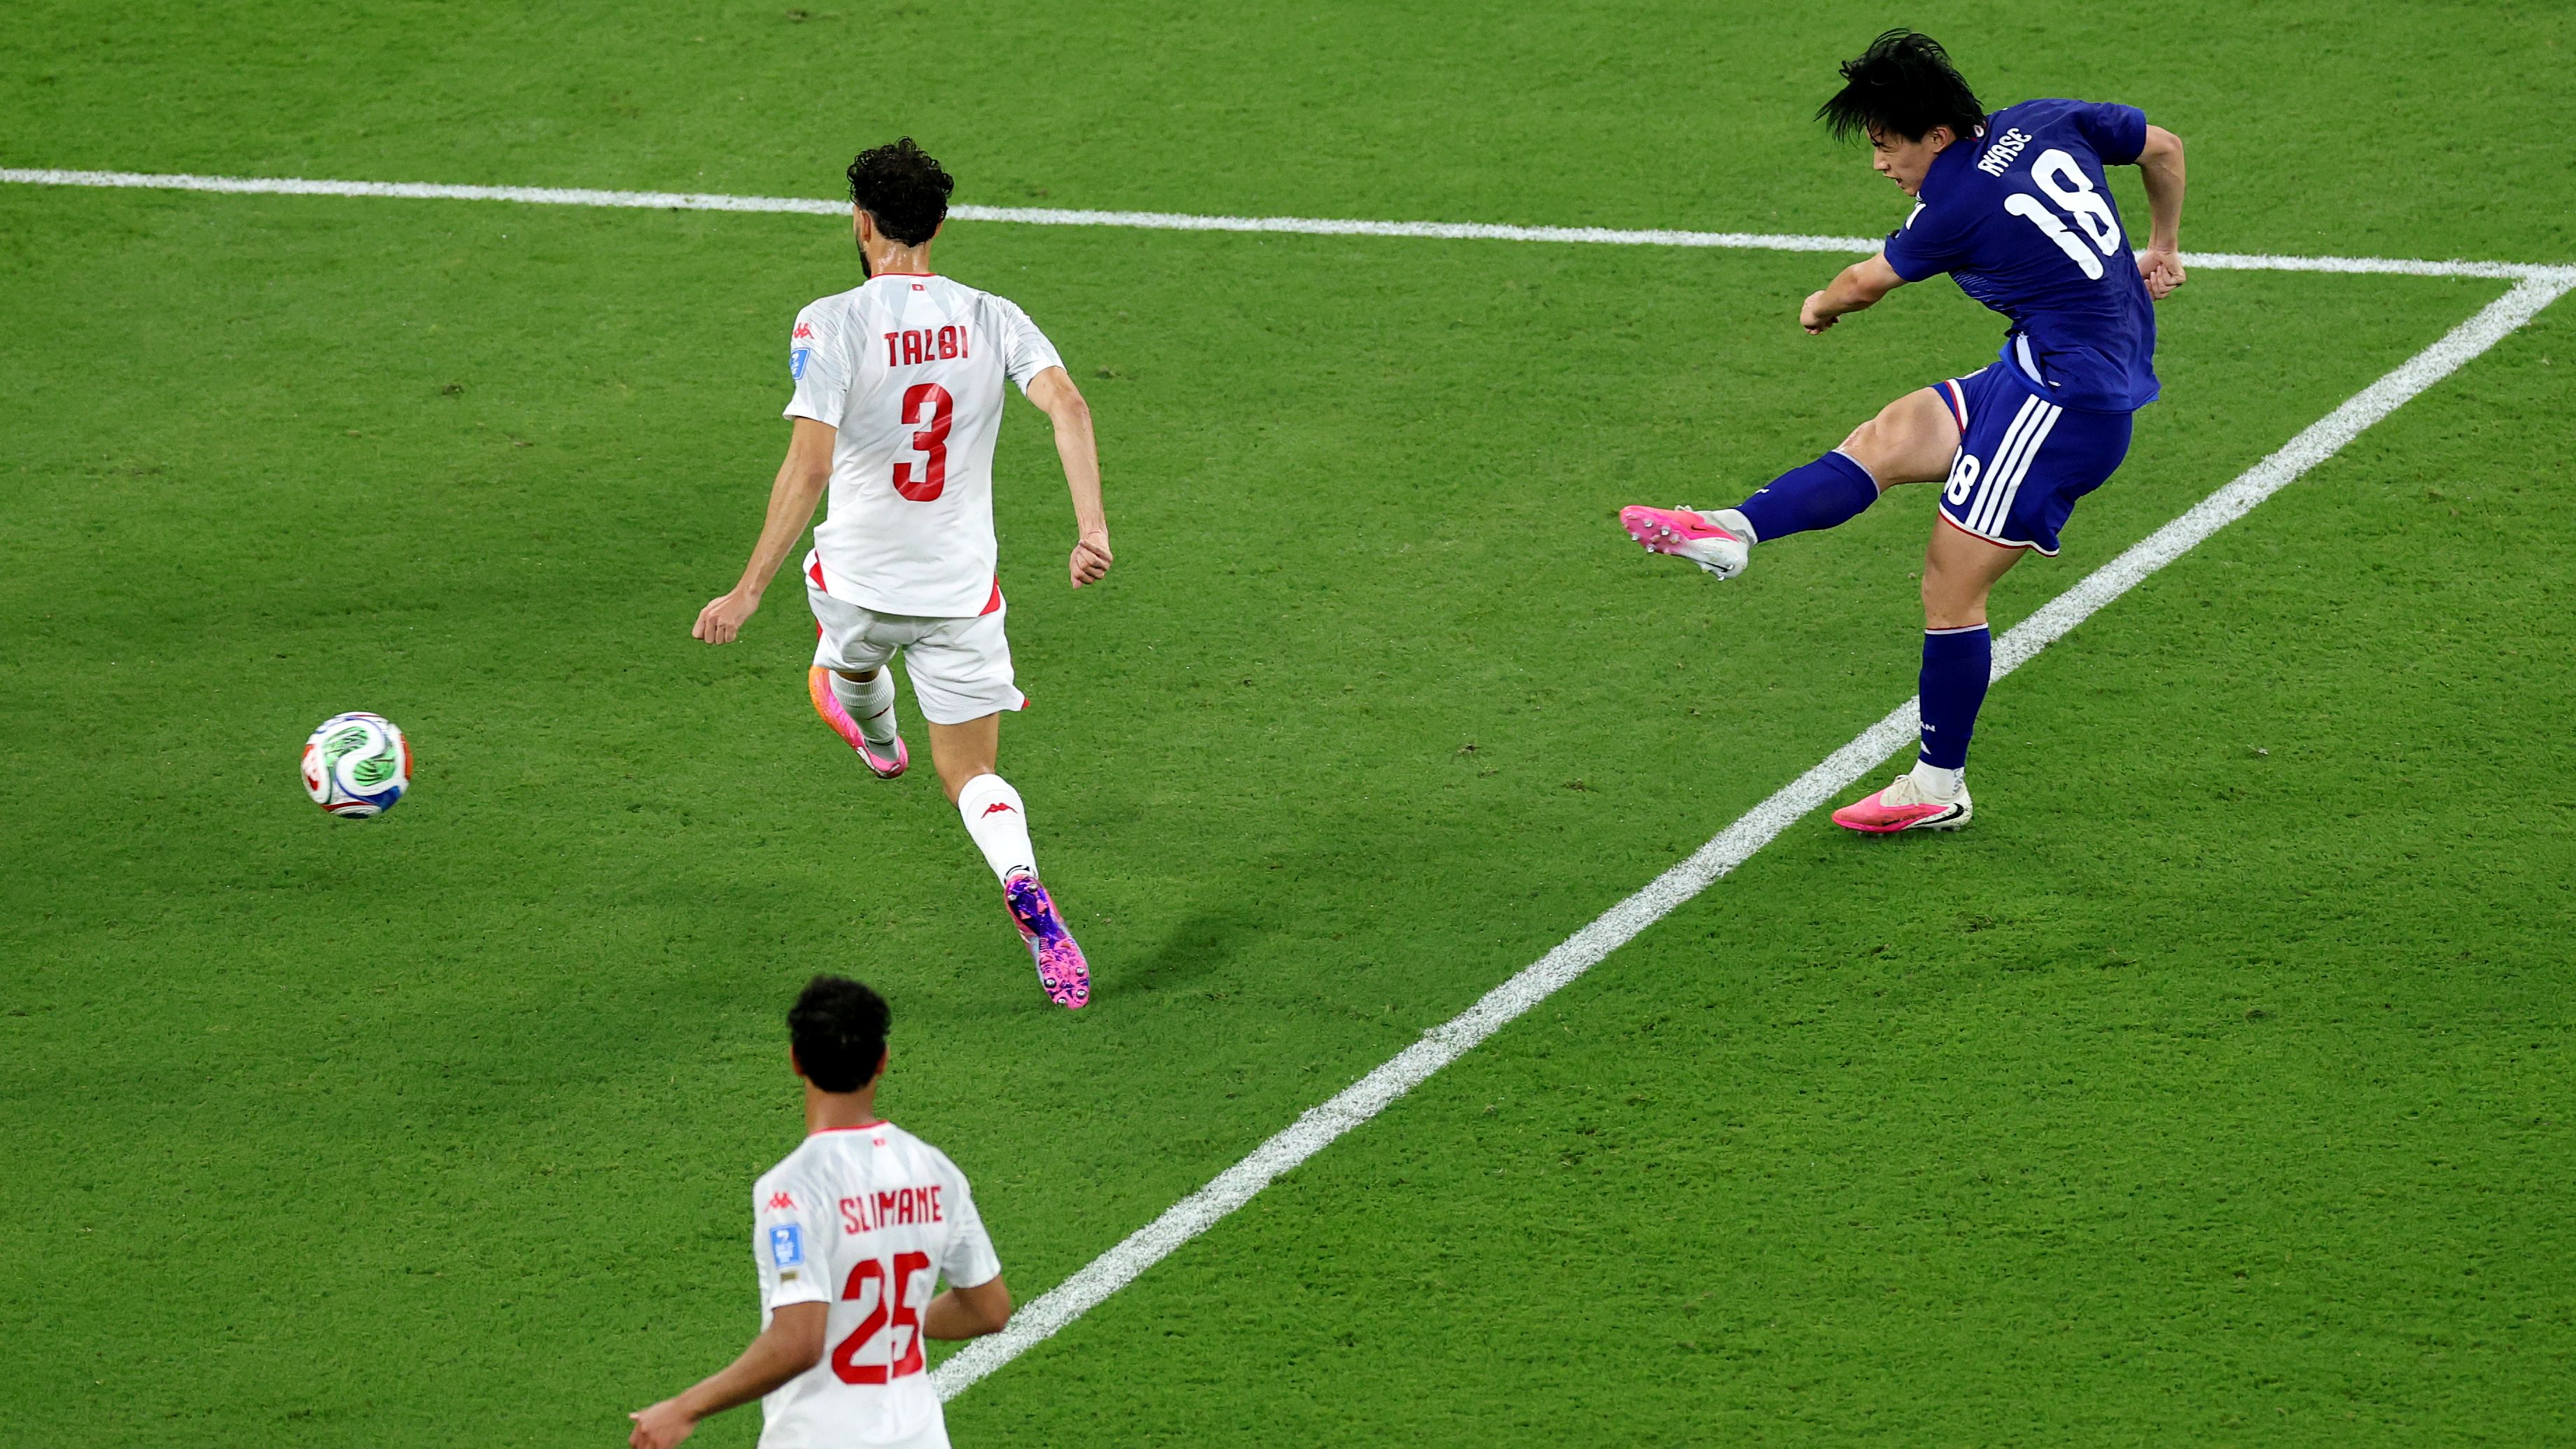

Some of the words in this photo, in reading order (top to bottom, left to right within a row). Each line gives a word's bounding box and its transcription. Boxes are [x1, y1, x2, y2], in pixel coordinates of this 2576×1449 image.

[1977, 127, 2032, 177] AYASE
[2004, 148, 2120, 280] 18
[883, 326, 968, 367] TALBI
[892, 382, 953, 502] 3
[839, 1185, 942, 1234] SLIMANE
[831, 1250, 930, 1385] 25
